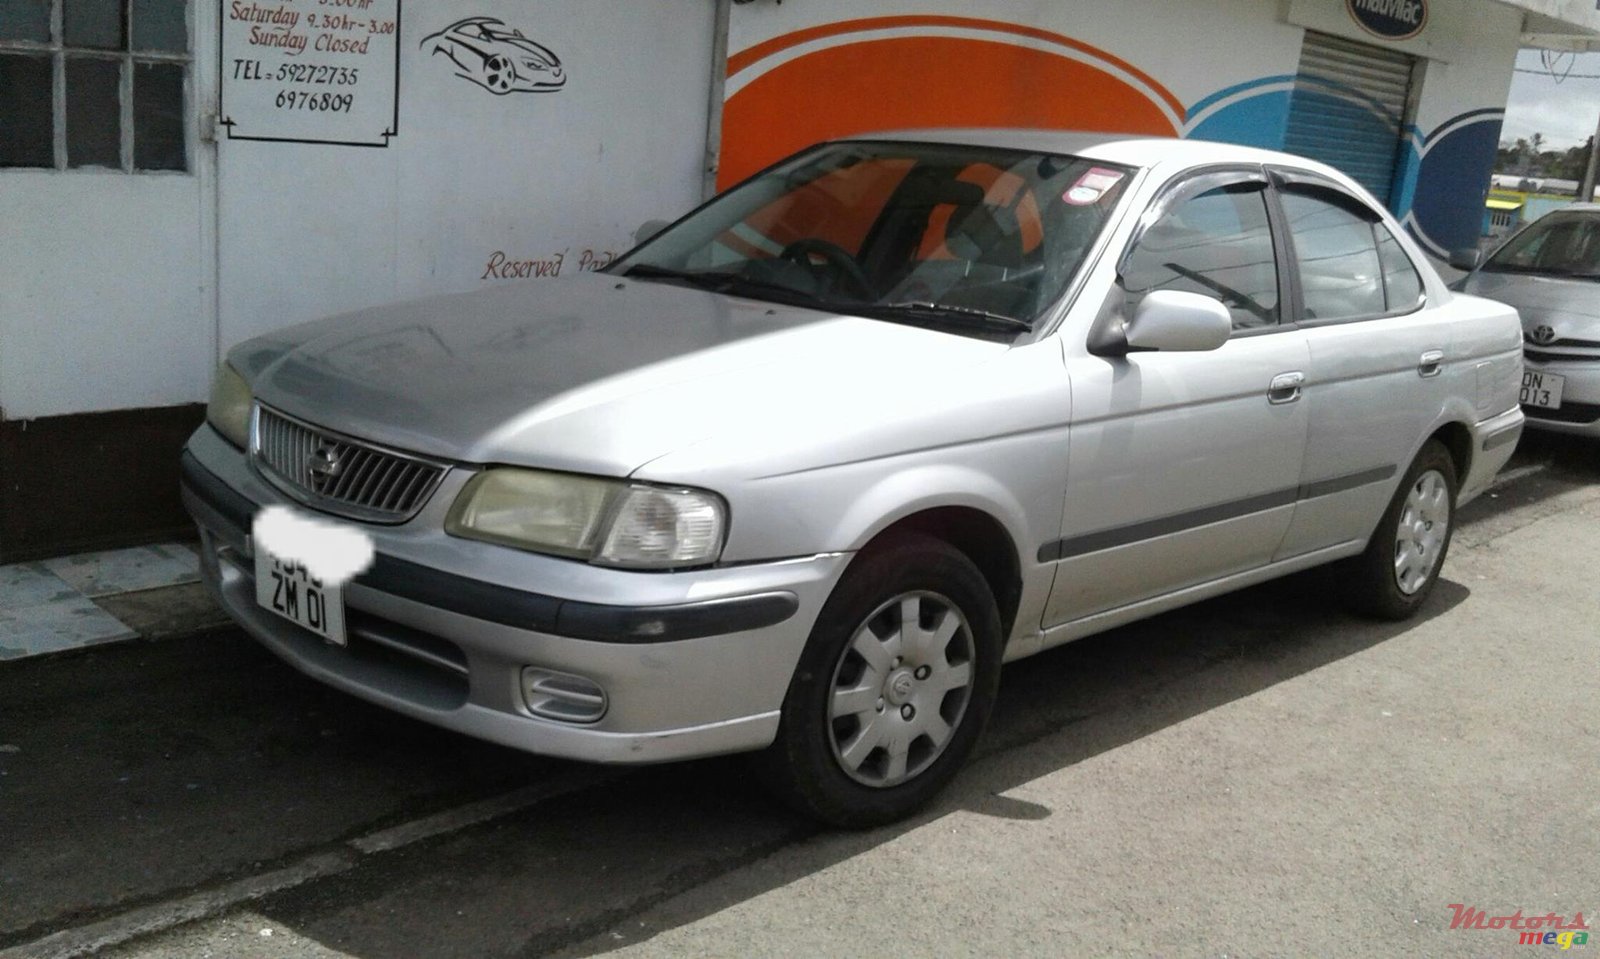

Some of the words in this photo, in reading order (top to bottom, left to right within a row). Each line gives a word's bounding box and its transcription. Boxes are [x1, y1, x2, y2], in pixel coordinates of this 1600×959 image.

[230, 1, 300, 30] Saturday
[249, 26, 307, 56] Sunday
[315, 33, 369, 55] Closed
[275, 90, 353, 113] 6976809
[481, 249, 566, 280] Reserved
[271, 570, 299, 621] ZM
